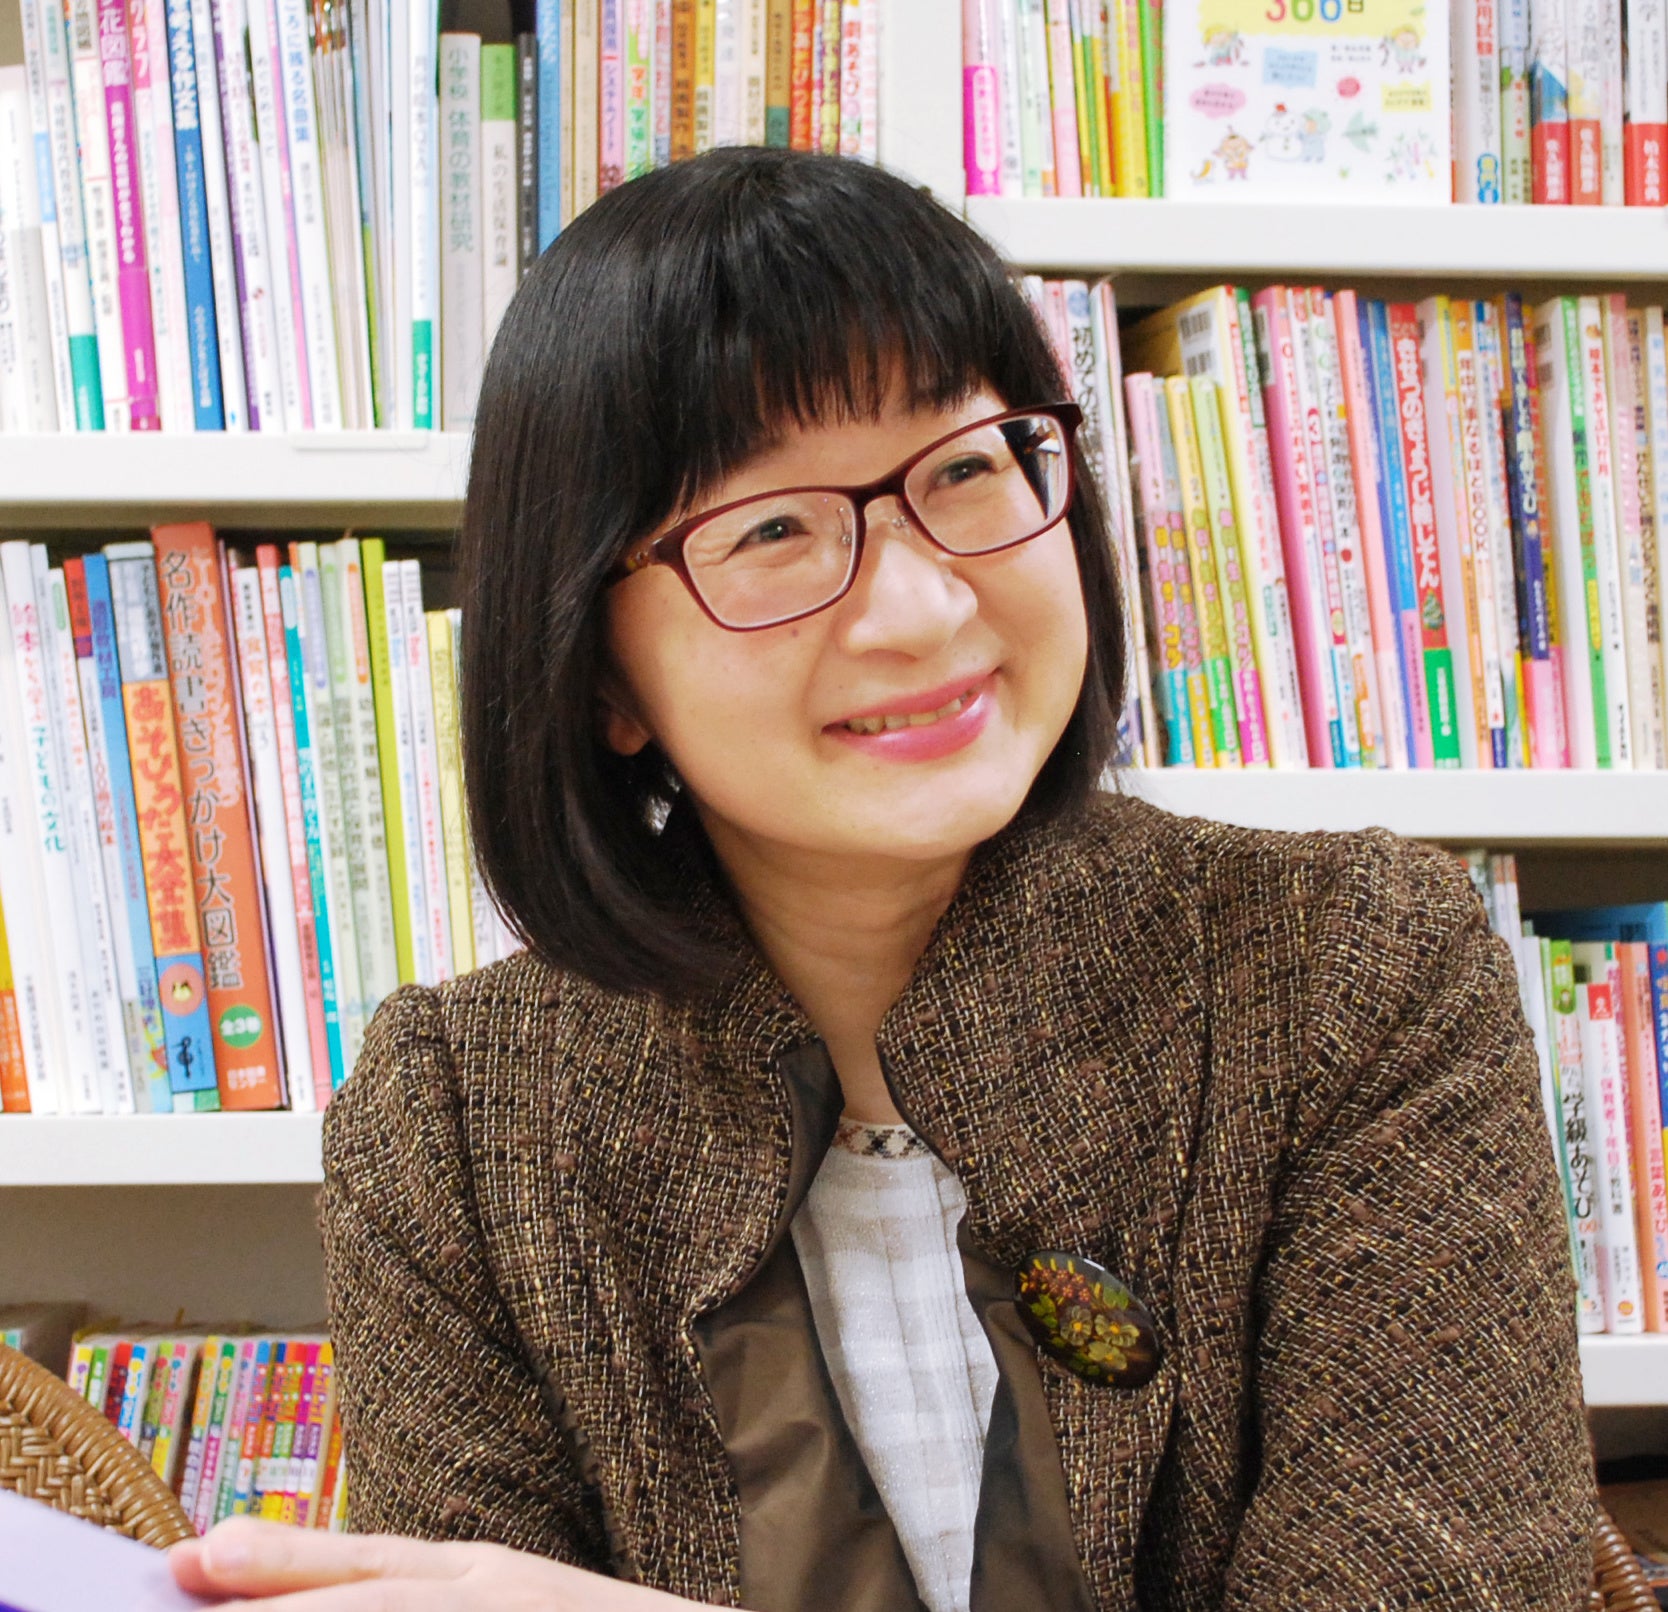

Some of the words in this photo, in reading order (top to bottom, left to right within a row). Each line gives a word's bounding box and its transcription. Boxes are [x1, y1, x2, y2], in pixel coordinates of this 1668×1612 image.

[132, 684, 194, 950] あそびうた大全集
[1563, 1092, 1595, 1220] 学級あそび
